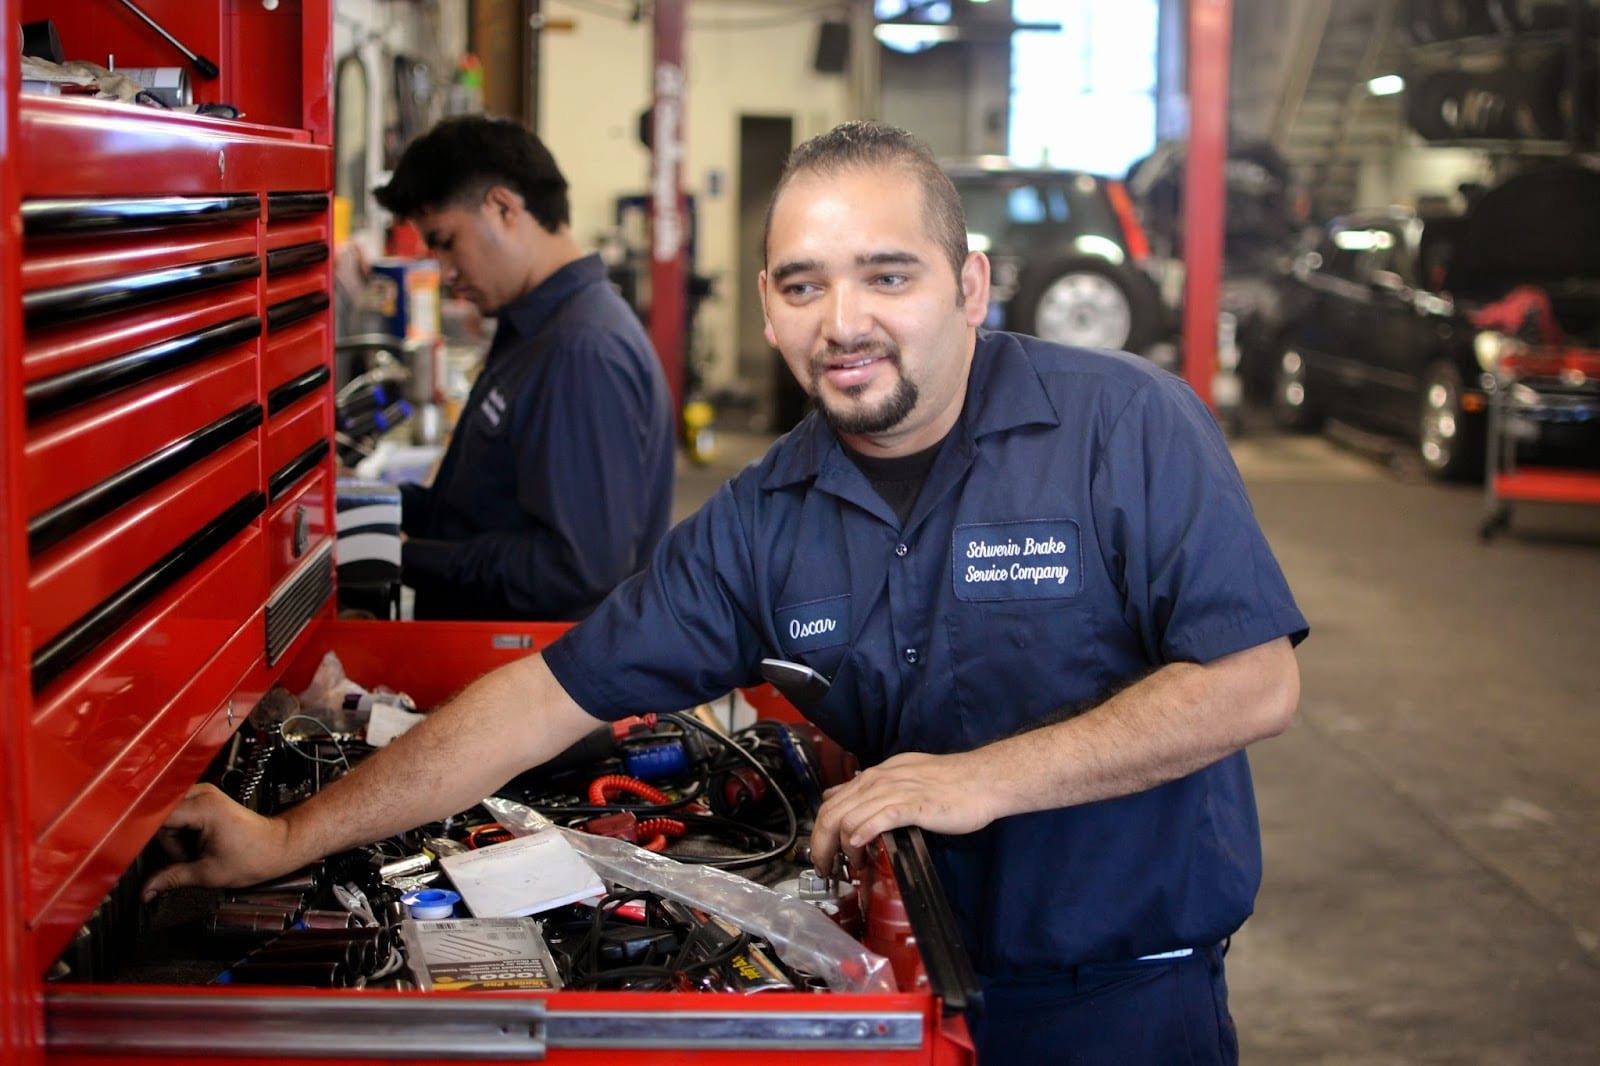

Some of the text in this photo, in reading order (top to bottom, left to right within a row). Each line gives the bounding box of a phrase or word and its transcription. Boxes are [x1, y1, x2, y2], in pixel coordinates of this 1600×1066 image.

[966, 536, 1067, 558] Schwerin Brake
[965, 563, 1069, 584] Service Company
[789, 618, 836, 639] Oscar
[480, 972, 546, 980] 1000
